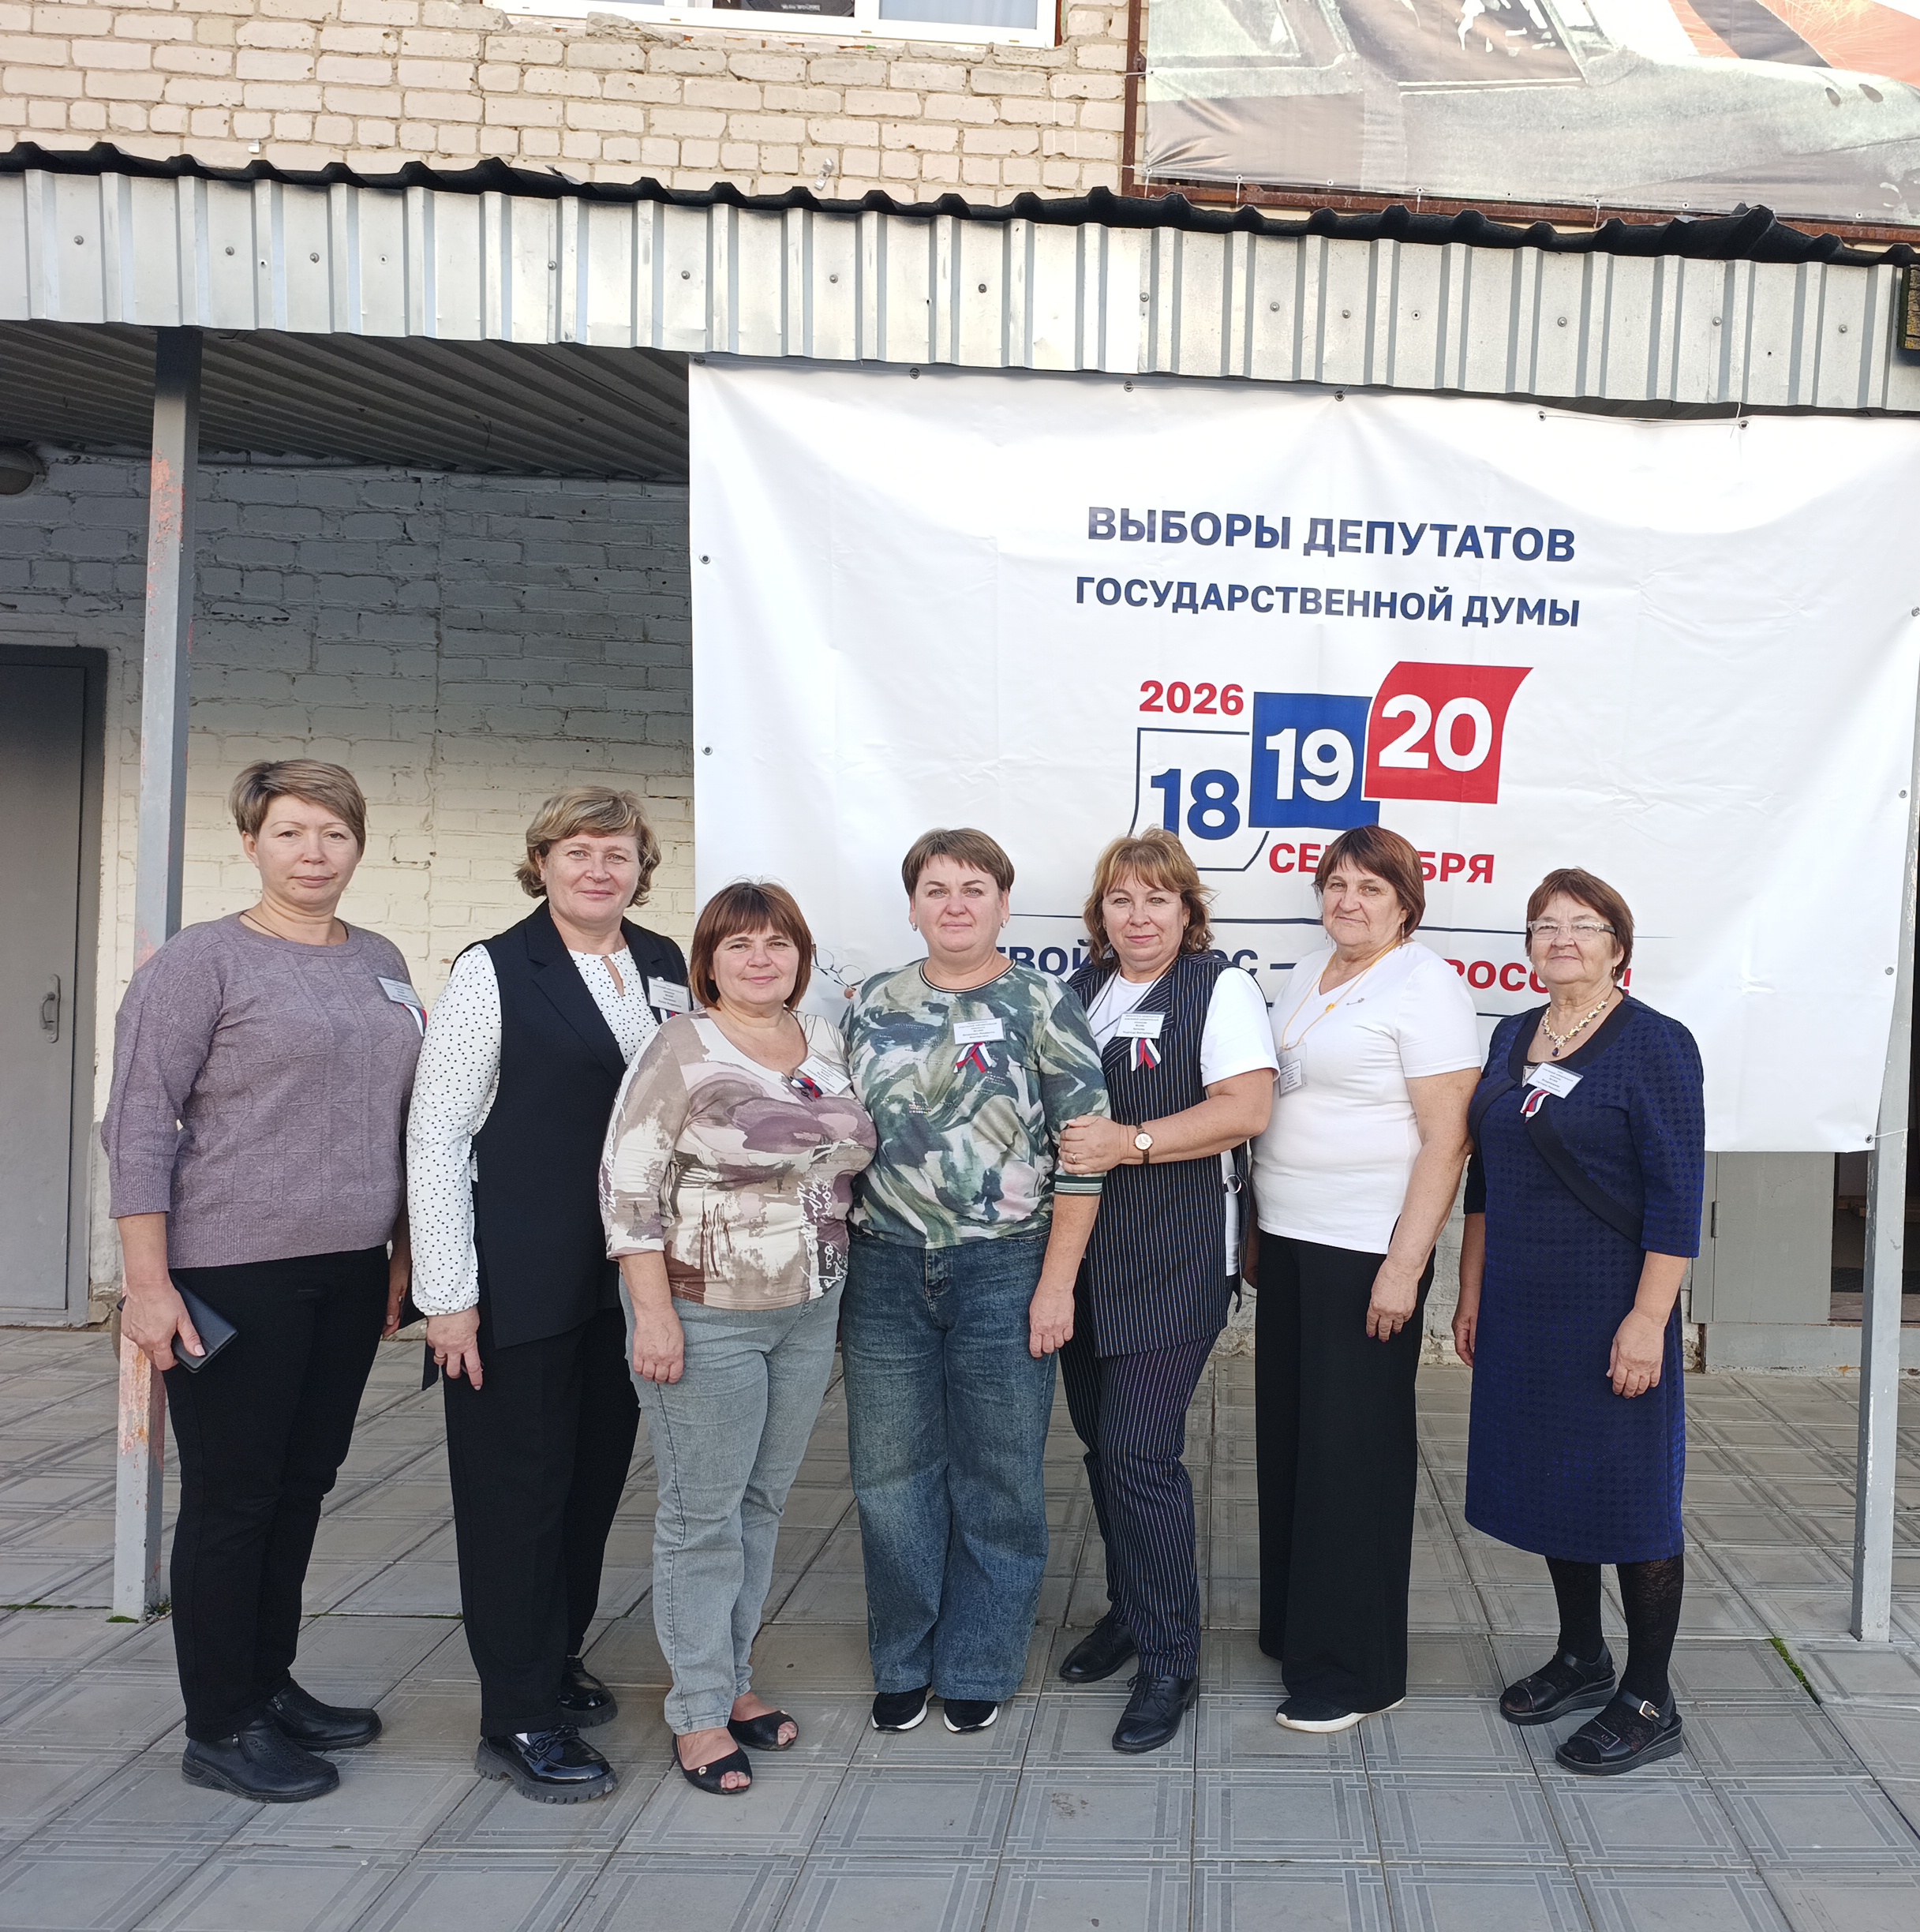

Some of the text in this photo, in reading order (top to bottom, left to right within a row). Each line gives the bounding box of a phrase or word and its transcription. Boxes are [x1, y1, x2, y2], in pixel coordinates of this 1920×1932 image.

[1088, 507, 1575, 562] ВЫБОРЫ ДЕПУТАТОВ
[1076, 576, 1579, 628] ГОСУДАРСТВЕННОЙ ДУМЫ
[1139, 680, 1244, 716] 2026
[1150, 694, 1494, 841] 18 19 20
[1269, 842, 1495, 884] СЕБРЯ
